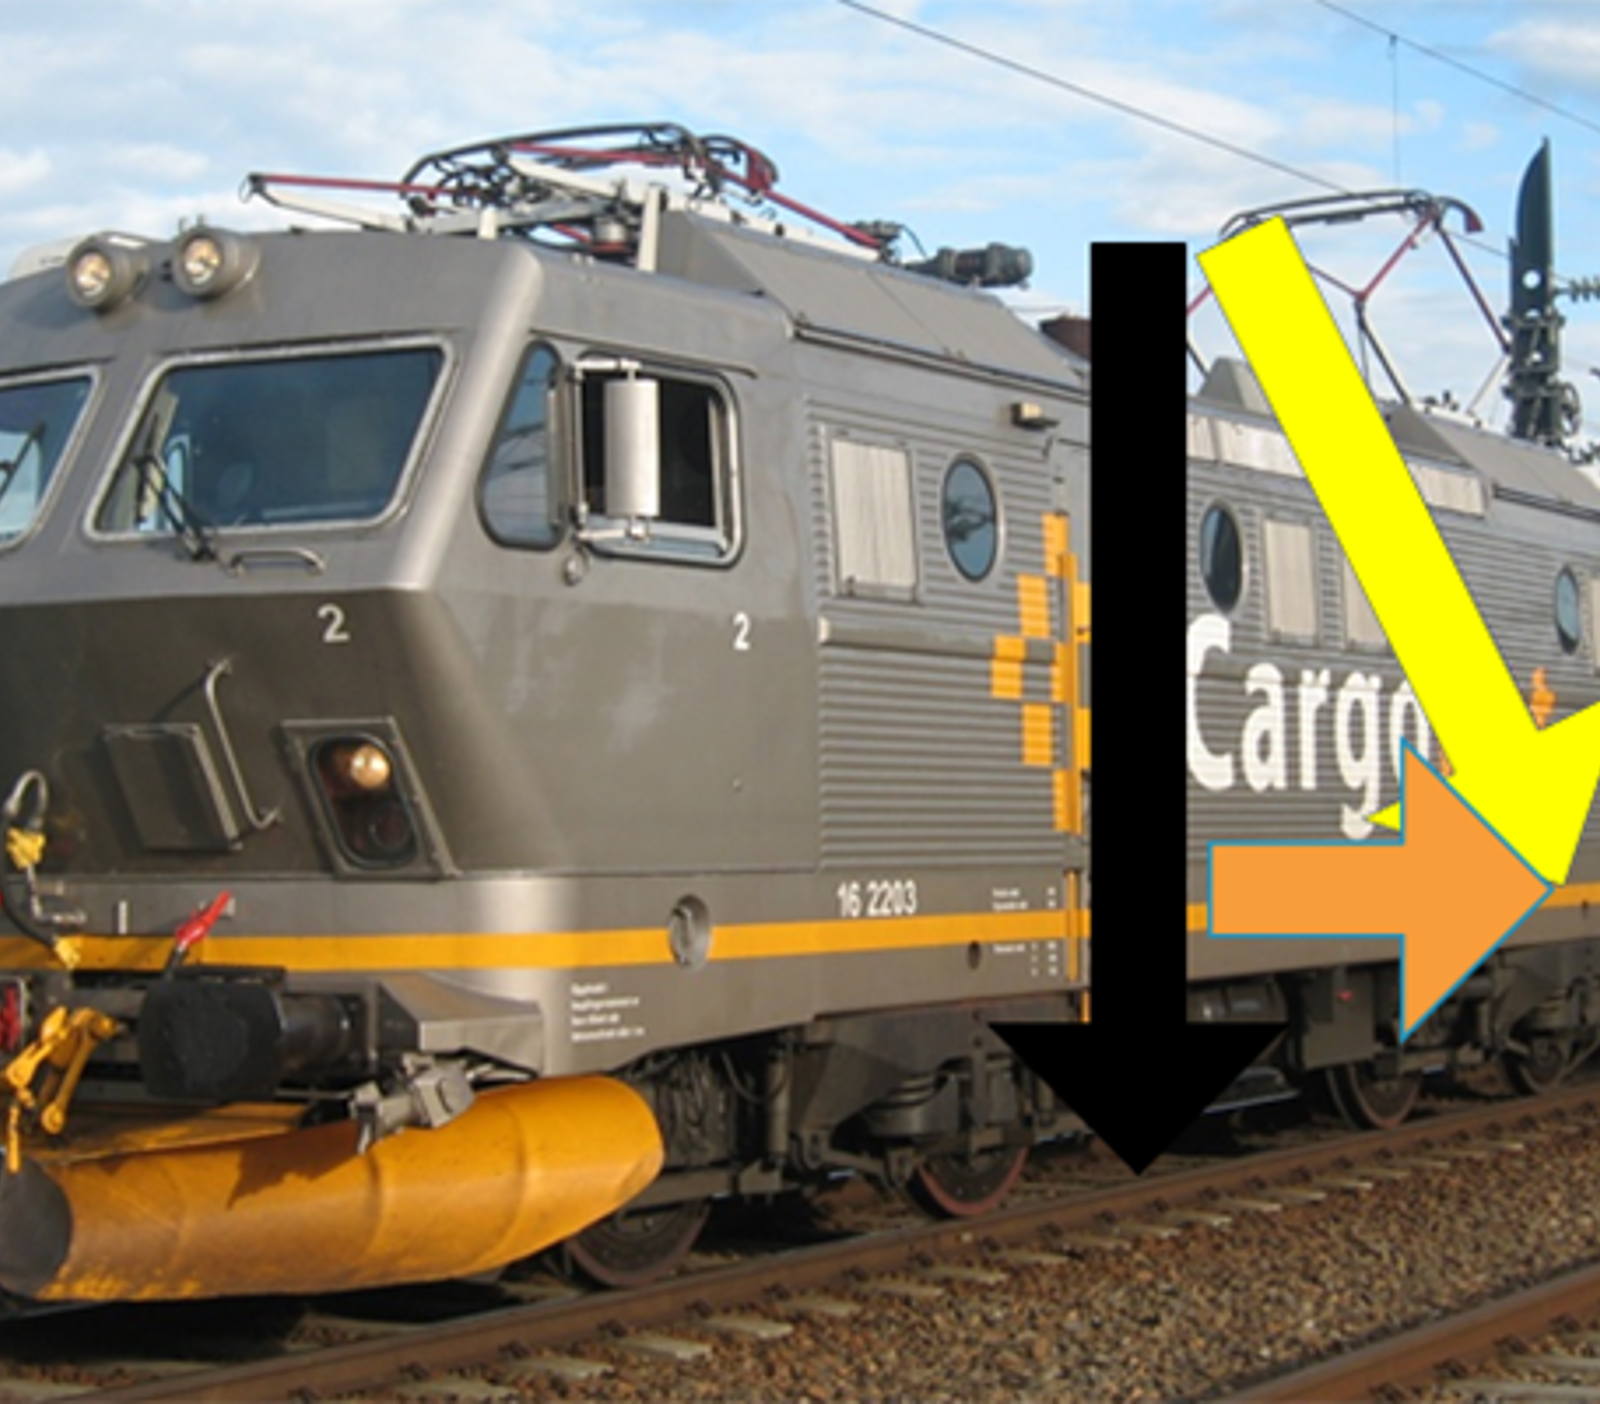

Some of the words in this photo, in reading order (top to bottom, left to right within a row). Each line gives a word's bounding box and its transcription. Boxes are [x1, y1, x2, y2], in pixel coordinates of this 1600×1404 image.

[317, 604, 350, 643] 2
[732, 611, 751, 650] 2
[1186, 613, 1557, 841] Cargo
[837, 881, 861, 918] 16
[866, 879, 918, 917] 2203
